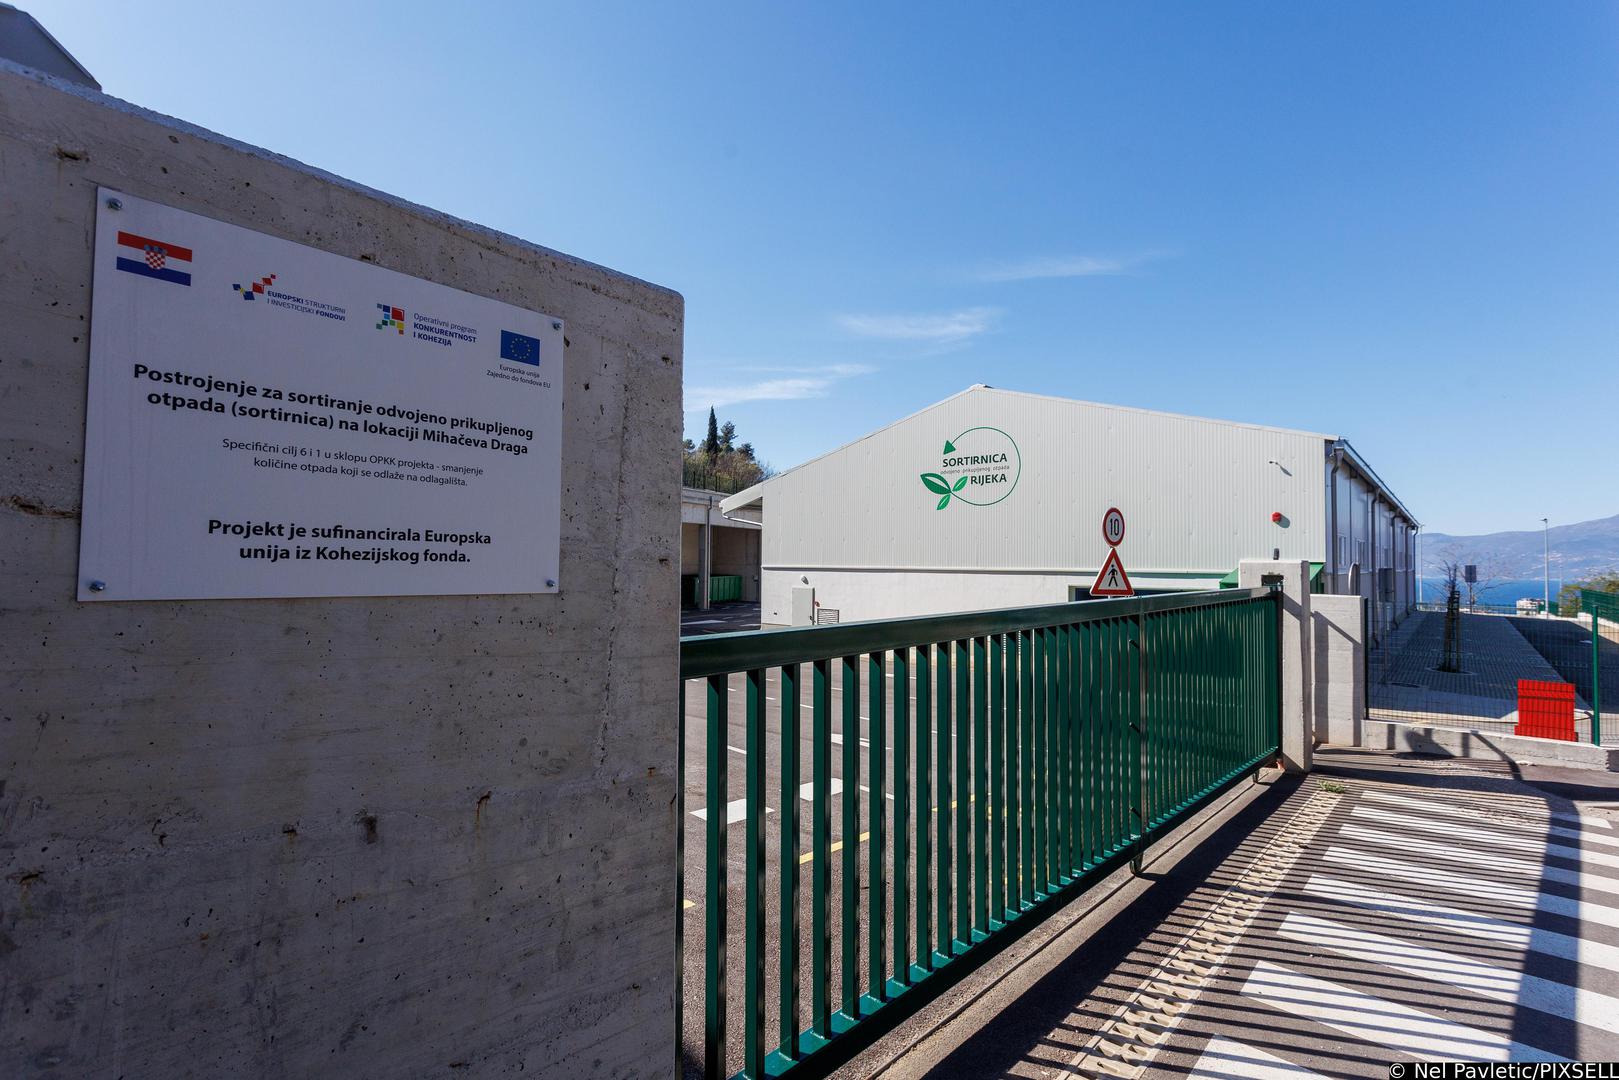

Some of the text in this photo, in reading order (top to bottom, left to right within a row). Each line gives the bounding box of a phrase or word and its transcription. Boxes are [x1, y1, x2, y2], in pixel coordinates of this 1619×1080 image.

[268, 291, 346, 314] EUROPSKI STRUKTURNI
[271, 300, 315, 315] INVESTICIJSKI
[316, 310, 346, 321] FONDOVI
[414, 313, 477, 334] Operativni program
[414, 323, 477, 343] KONKURENTNOST
[418, 333, 452, 346] KOHEZIJA
[487, 370, 510, 380] Zajedno
[520, 377, 542, 386] fondova
[500, 365, 525, 375] Europska
[134, 364, 533, 440] Postrojenje za sortiranje odvojeno prikupljenog
[147, 392, 528, 455] otpada (sortirnica) na lokaciji Mihačeva Draga
[222, 438, 279, 453] Specifični
[282, 446, 297, 457] cilj
[300, 448, 307, 456] 6
[316, 449, 321, 457] 1
[334, 451, 367, 464] sklopu
[369, 455, 396, 466] OPKK
[398, 458, 434, 470] projekta
[442, 464, 483, 476] smanjenje
[943, 453, 1007, 467] SORTIRNICA
[254, 457, 298, 470] količine
[300, 464, 338, 474] otpada
[341, 466, 358, 477] koji
[374, 470, 405, 480] odlaže
[420, 475, 468, 486] odlagališta.
[971, 474, 1007, 486] RIJEKA
[208, 519, 491, 546] Projekt je sufinancirala Europska
[1110, 518, 1120, 536] 10
[240, 545, 471, 564] unija iz Kohezijskog fonda.
